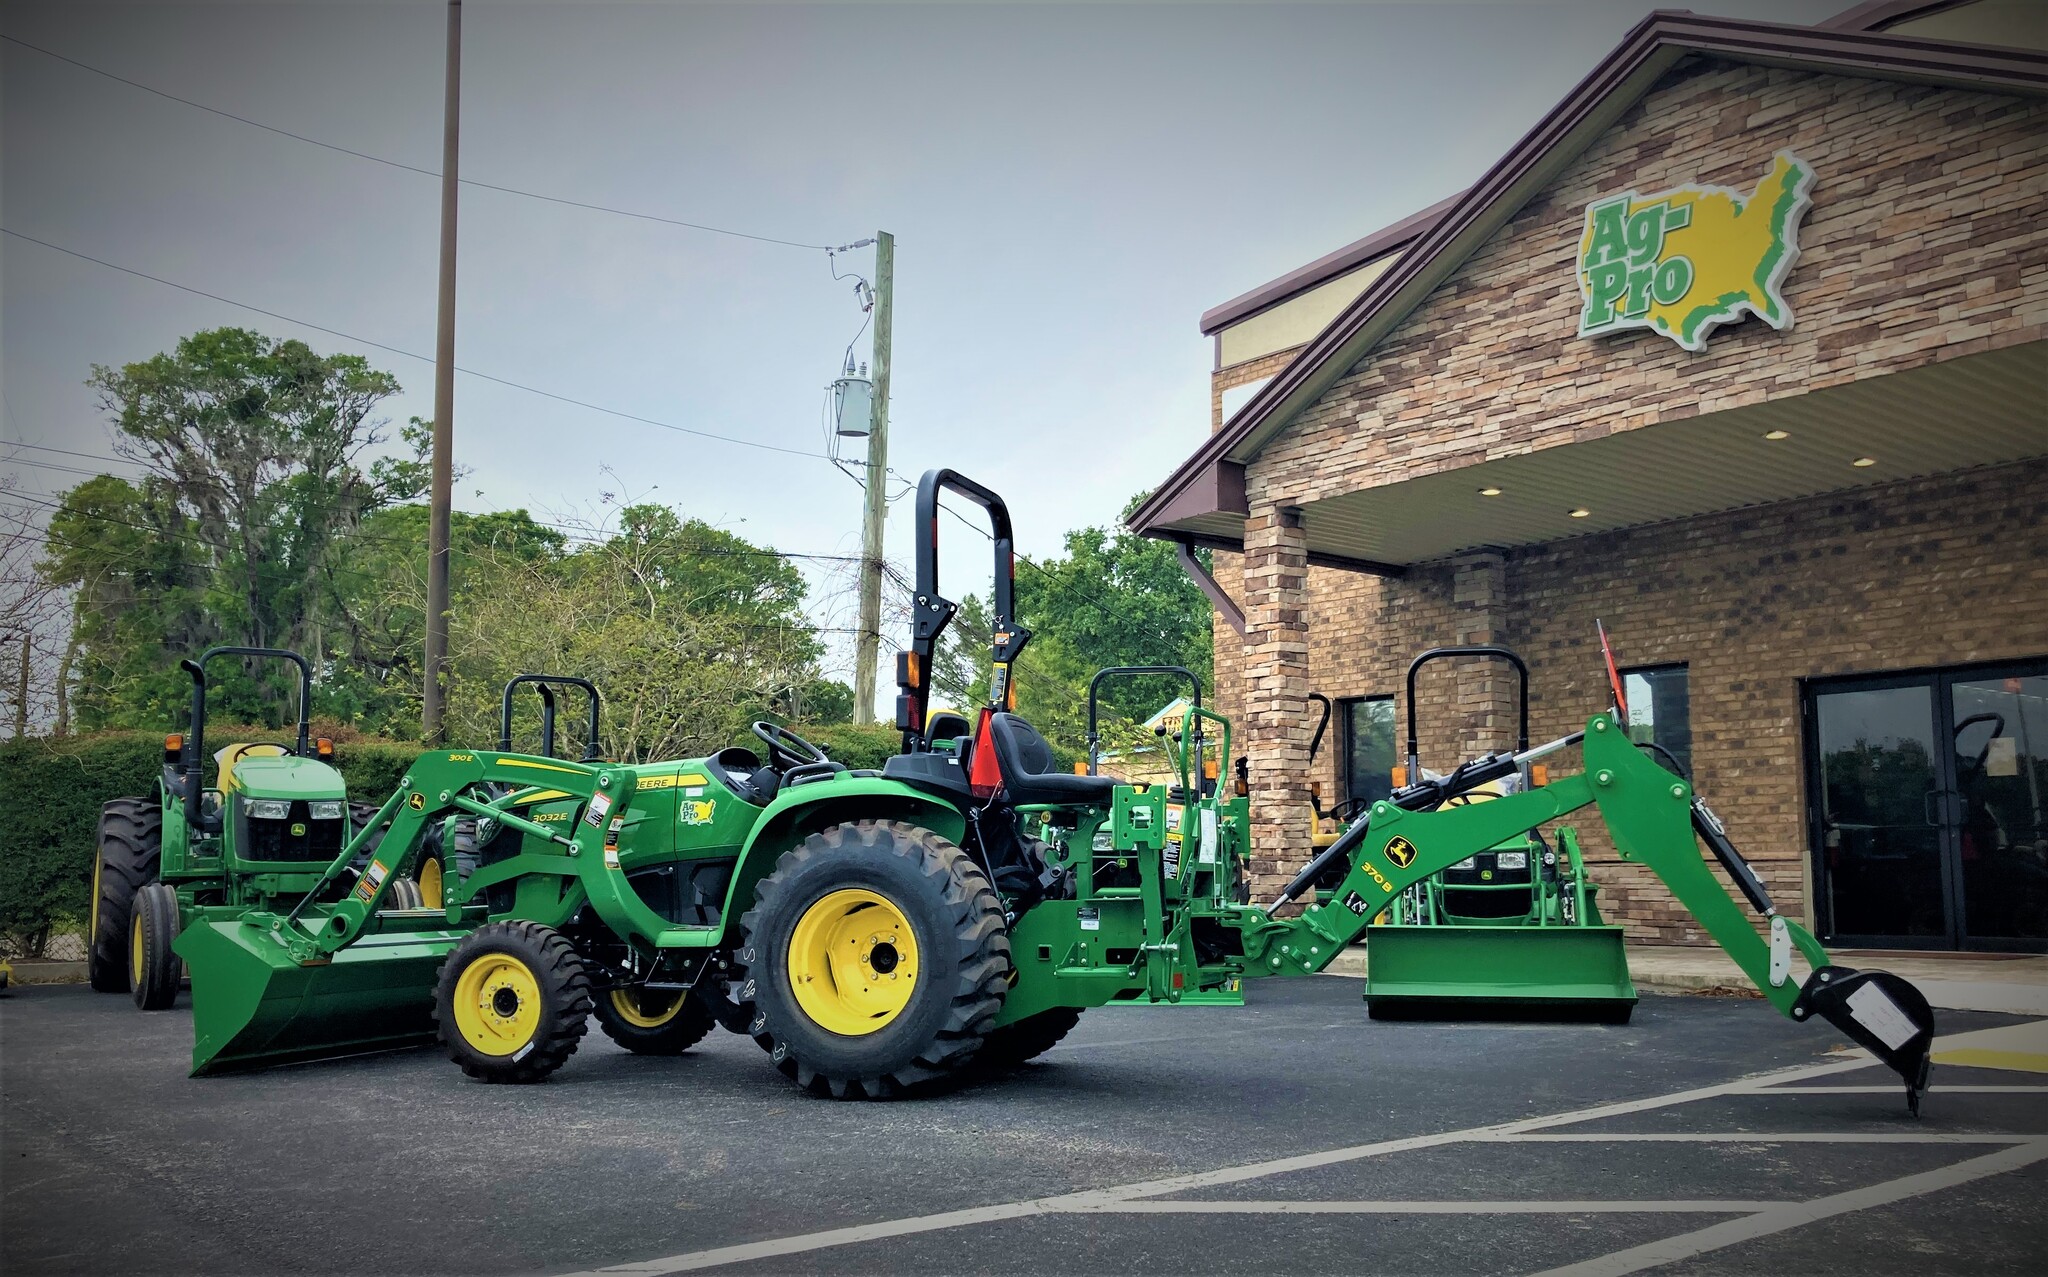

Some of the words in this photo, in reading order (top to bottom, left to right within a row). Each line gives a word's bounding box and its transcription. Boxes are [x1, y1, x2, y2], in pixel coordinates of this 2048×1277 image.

[1582, 196, 1692, 272] Ag-
[1584, 254, 1695, 330] Pro
[532, 812, 569, 822] 3032E
[682, 811, 700, 820] Pro
